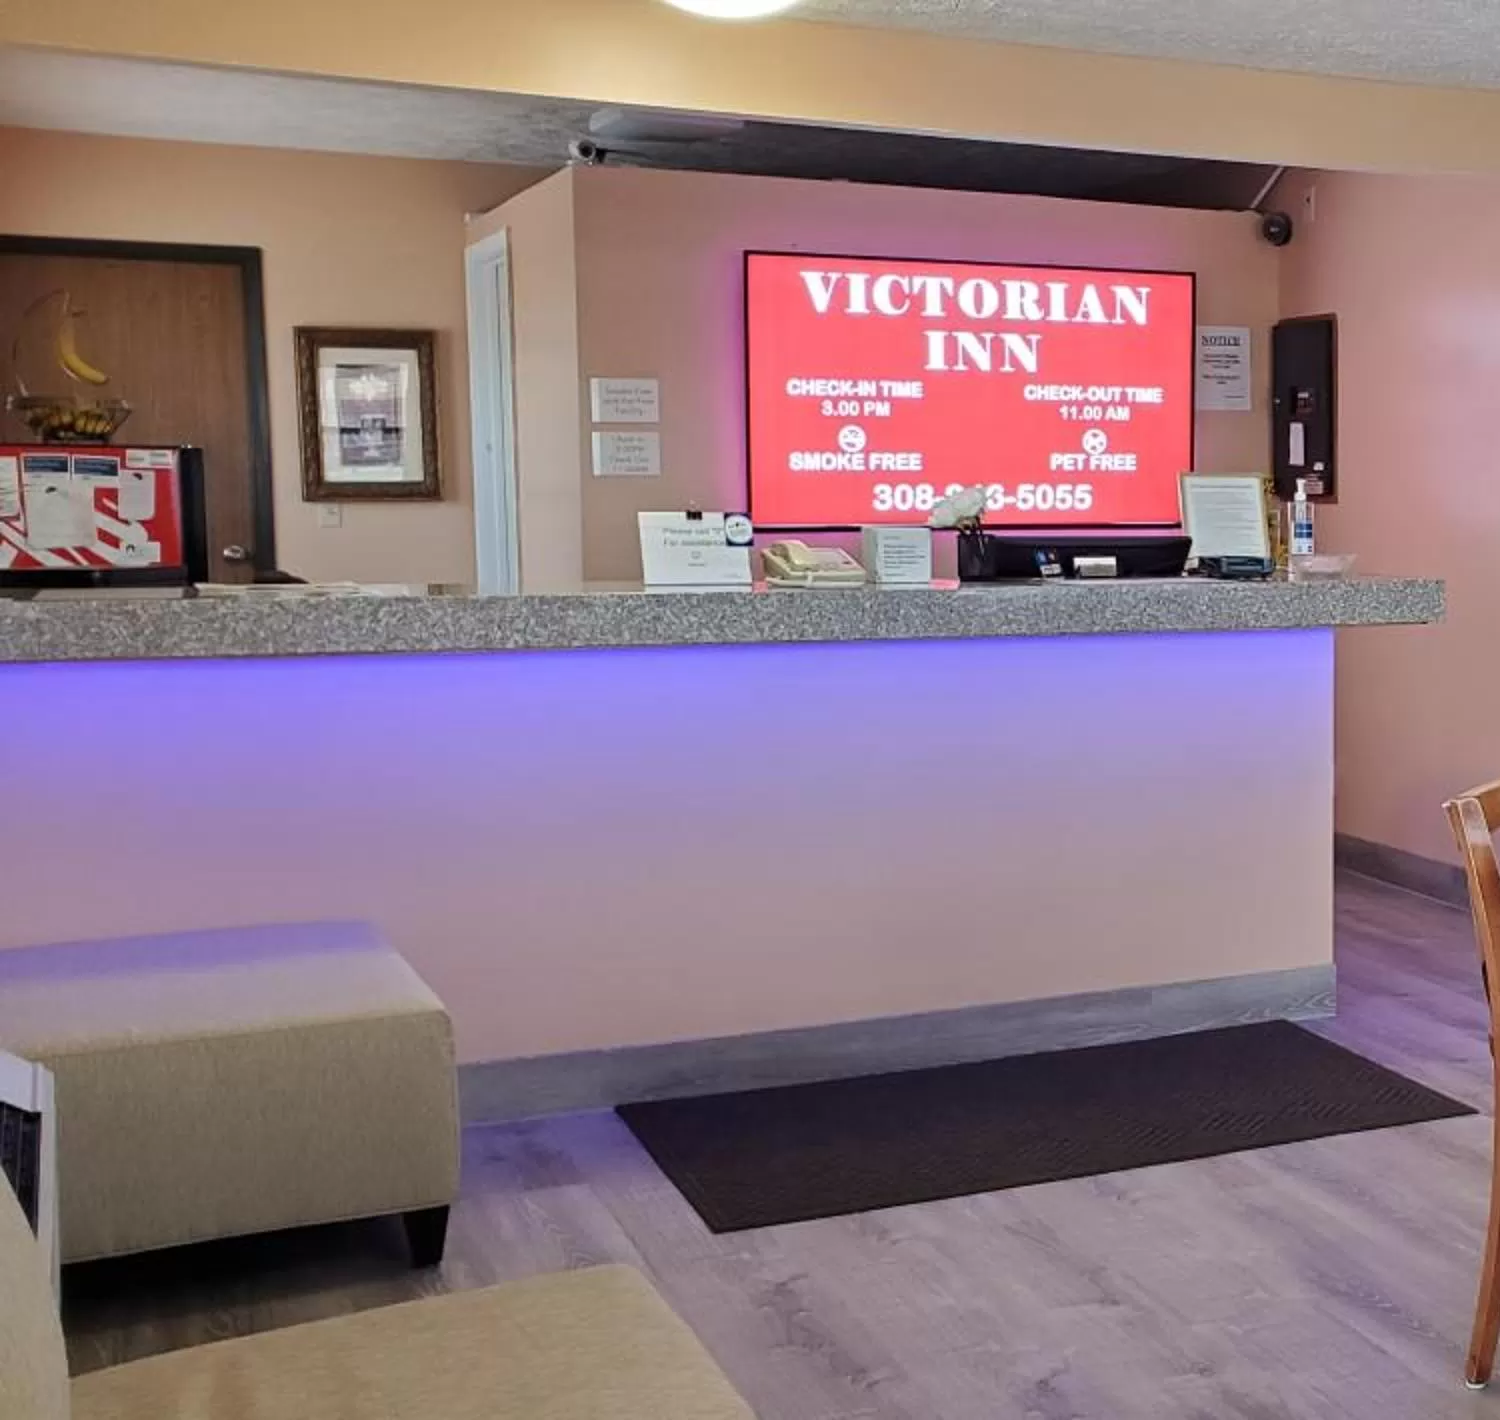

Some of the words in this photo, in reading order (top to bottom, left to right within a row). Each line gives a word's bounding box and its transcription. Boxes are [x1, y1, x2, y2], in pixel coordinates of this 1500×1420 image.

[799, 271, 1151, 325] VICTORIAN
[1201, 335, 1241, 346] NOTICE
[923, 330, 1042, 373] INN
[786, 377, 877, 396] CHECK-IN
[879, 380, 924, 398] TIME
[1023, 384, 1122, 402] CHECK-OUT
[1124, 387, 1164, 403] TIME
[821, 399, 860, 416] 3.00
[863, 400, 891, 417] PM
[1059, 405, 1102, 420] 11.00
[1104, 406, 1131, 421] AM
[788, 451, 866, 471] SMOKE
[869, 452, 923, 471] FREE
[1050, 452, 1088, 471] PET
[1089, 453, 1137, 471] FREE
[872, 483, 1094, 511] 308-3-5055
